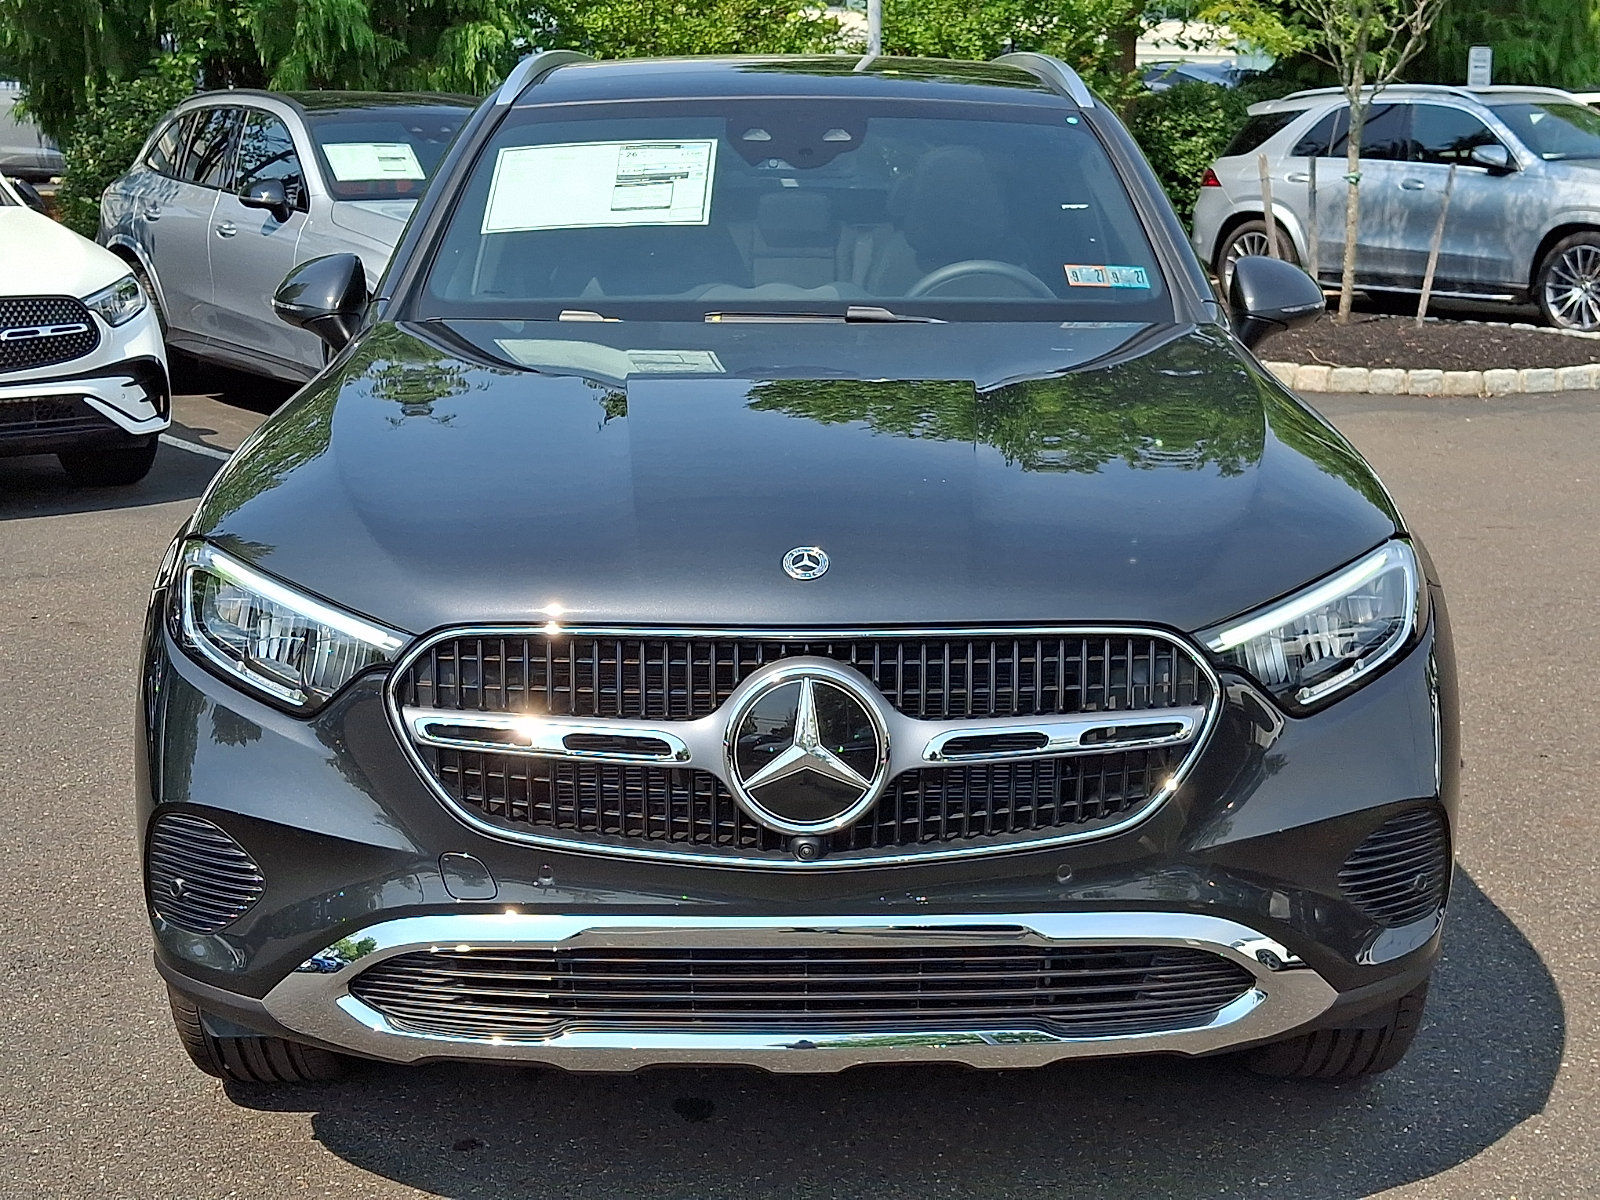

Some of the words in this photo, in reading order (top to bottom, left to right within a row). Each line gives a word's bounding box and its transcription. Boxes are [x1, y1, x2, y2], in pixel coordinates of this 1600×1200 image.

[1071, 270, 1080, 282] 9
[1094, 269, 1105, 283] 27
[1111, 271, 1120, 284] 9
[1134, 270, 1145, 284] 27
